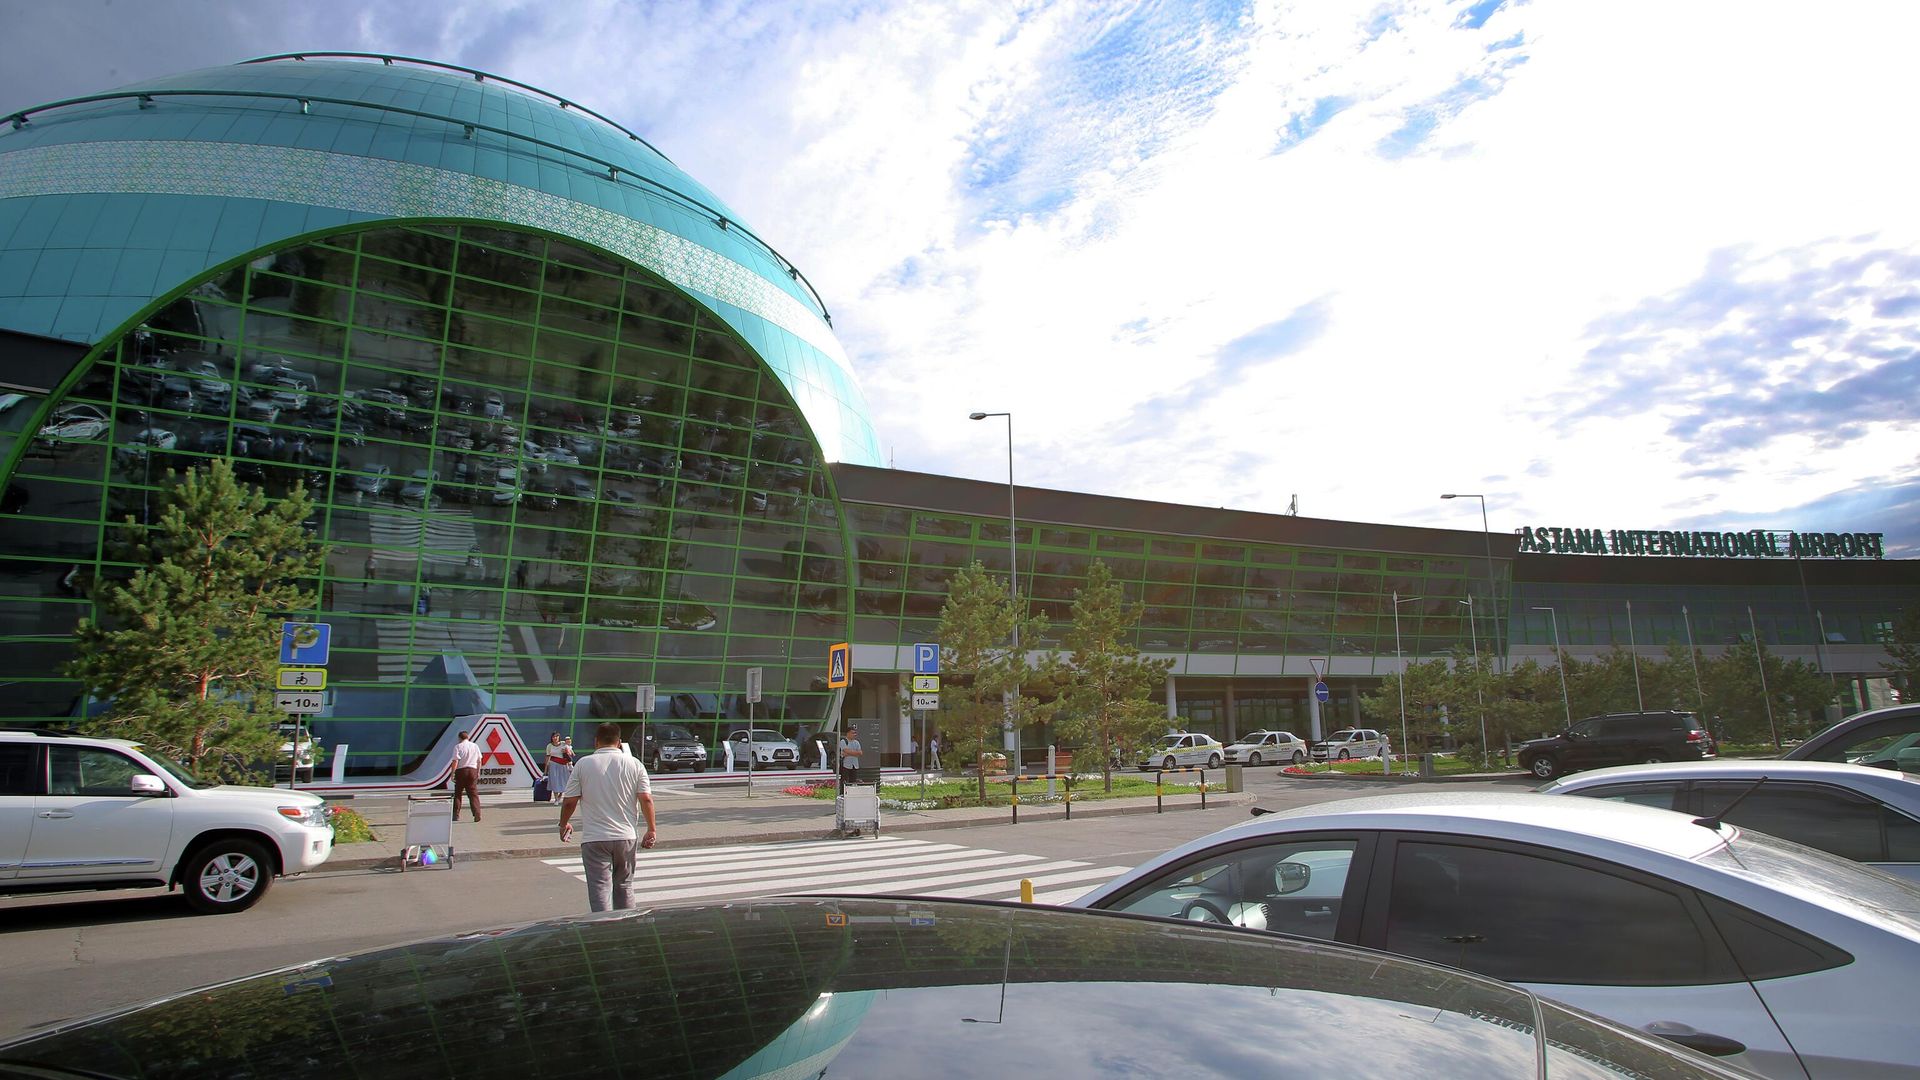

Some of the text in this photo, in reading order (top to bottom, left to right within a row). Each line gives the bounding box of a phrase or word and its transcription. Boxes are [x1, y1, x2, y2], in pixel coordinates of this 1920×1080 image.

[1520, 526, 1884, 558] ASTANA INTERNATIONAL AIRPORT
[919, 646, 934, 672] P
[479, 767, 512, 776] TSUBISHI
